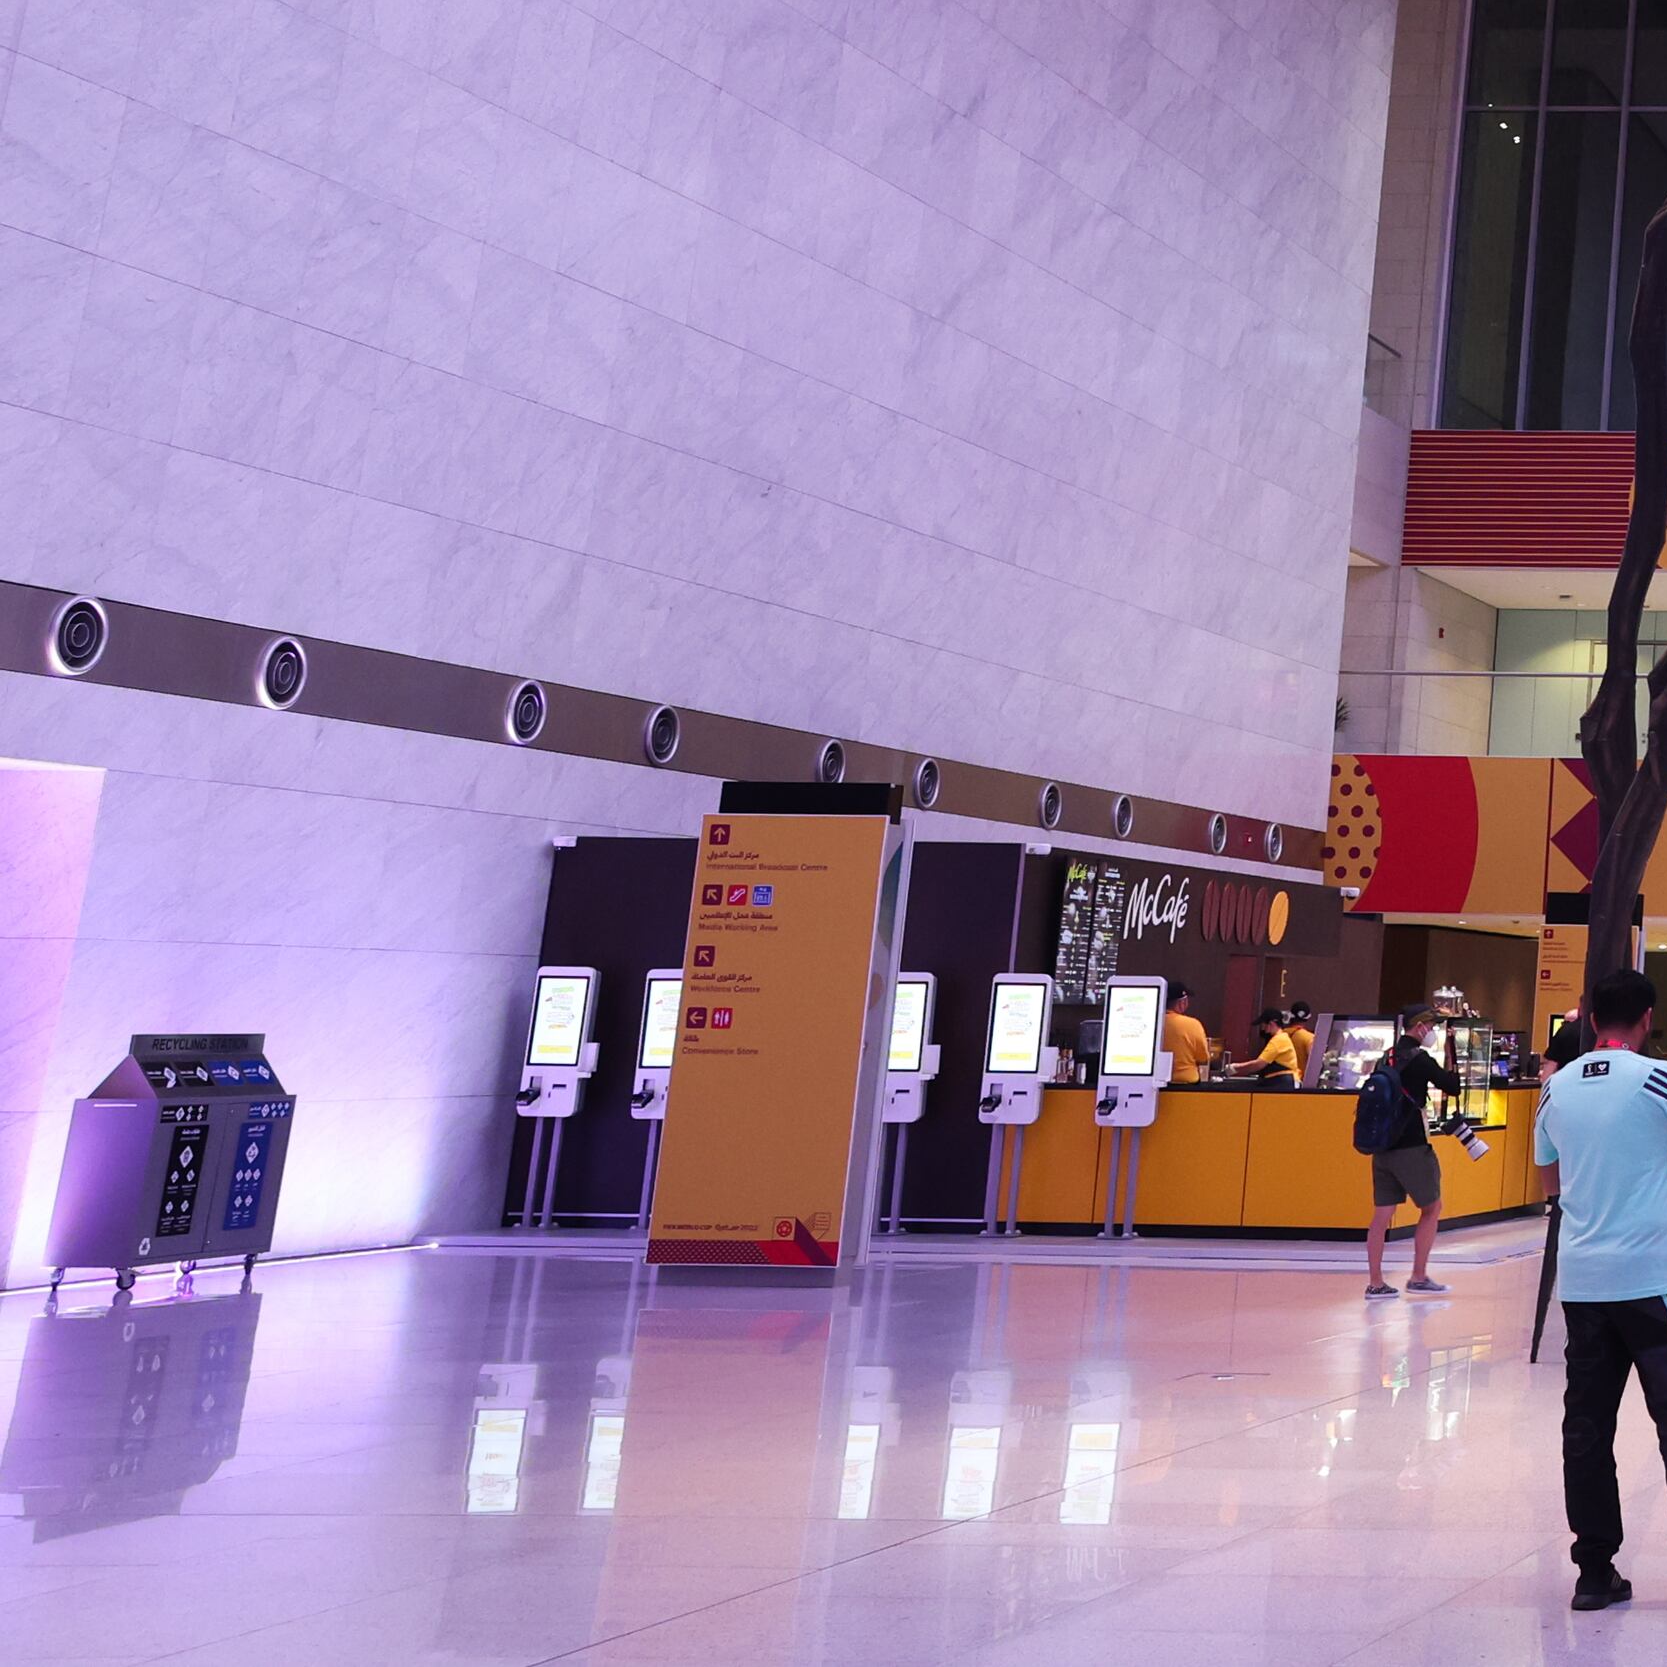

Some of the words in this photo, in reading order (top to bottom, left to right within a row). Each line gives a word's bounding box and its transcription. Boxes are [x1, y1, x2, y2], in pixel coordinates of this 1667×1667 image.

[1122, 873, 1190, 945] McCafé
[151, 1038, 208, 1051] RECYCLING
[209, 1037, 249, 1050] STATION
